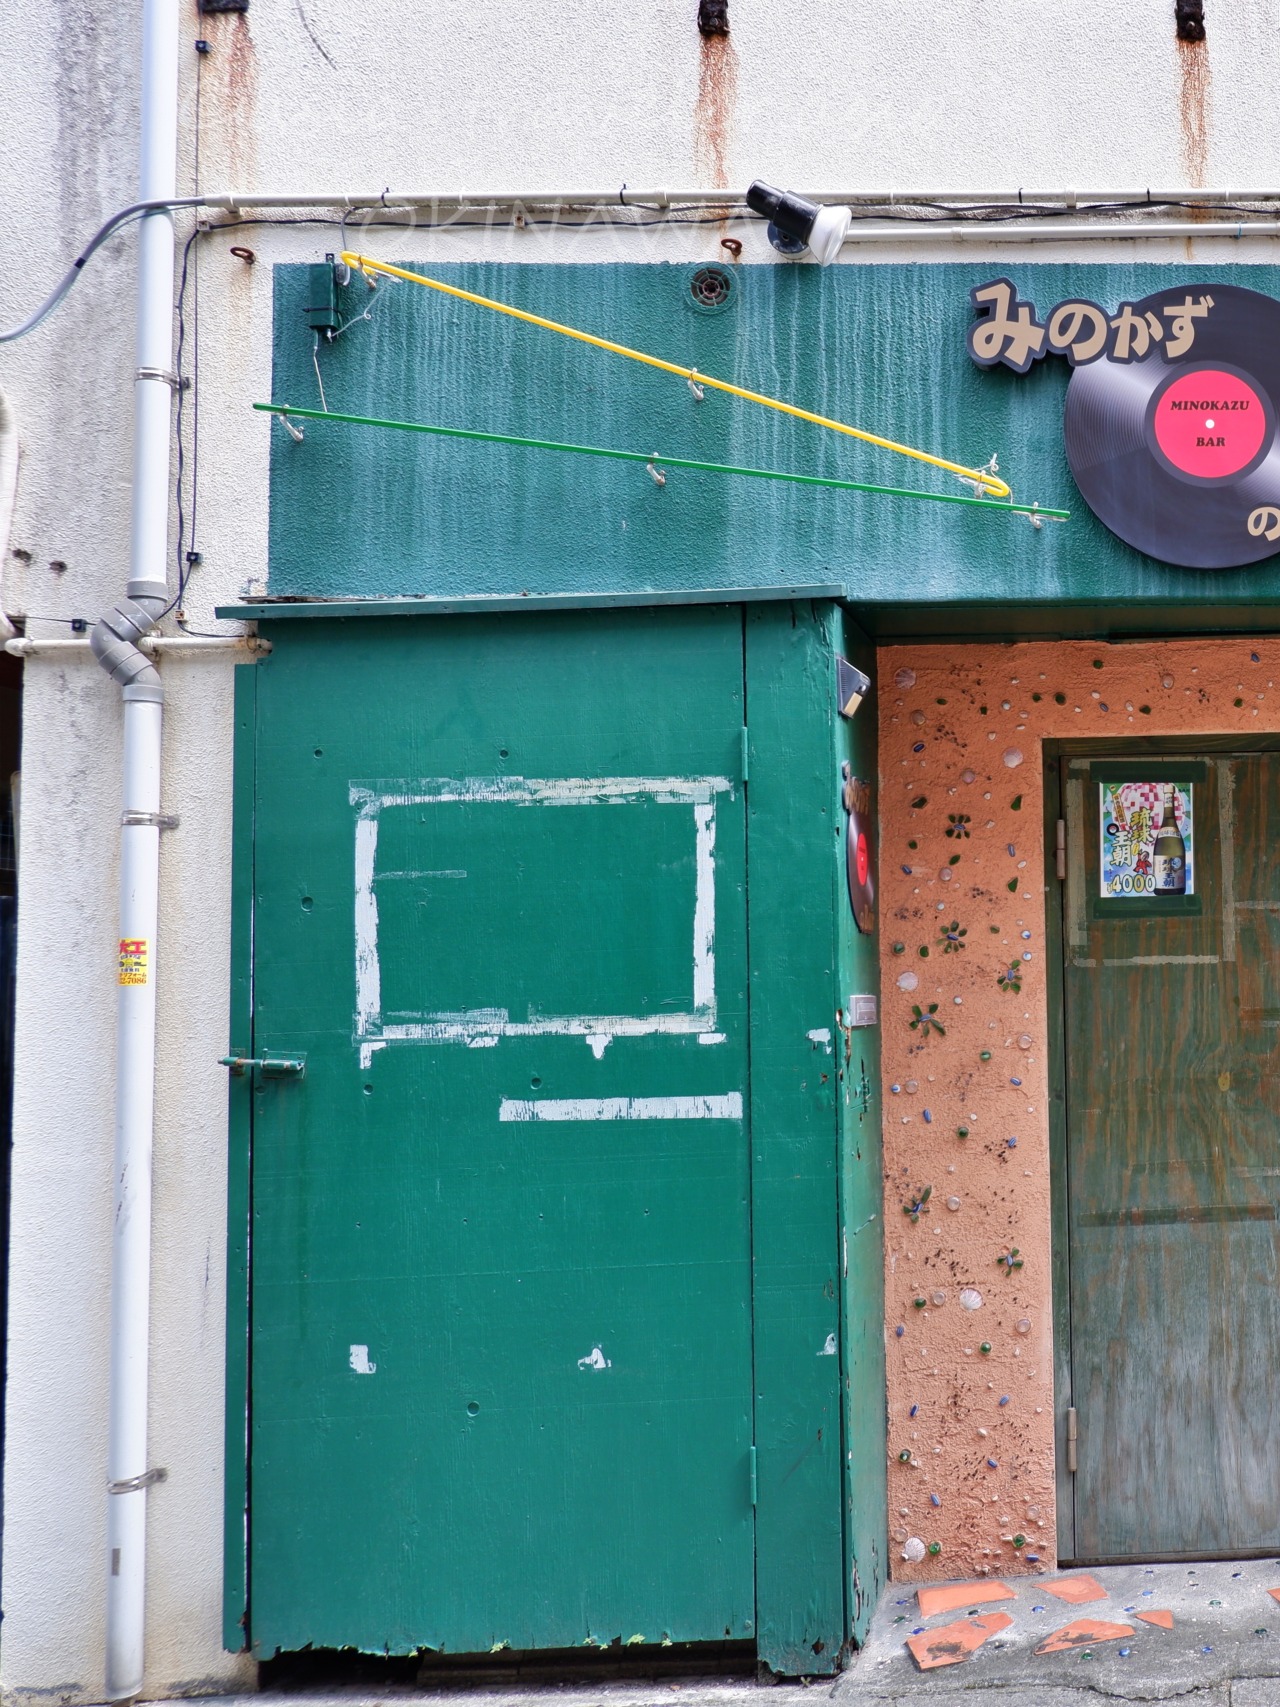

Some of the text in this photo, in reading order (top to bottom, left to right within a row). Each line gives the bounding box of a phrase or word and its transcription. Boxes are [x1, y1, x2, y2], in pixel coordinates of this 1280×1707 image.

[972, 282, 1215, 366] みのかず
[1170, 400, 1250, 411] MINOKAZU
[1195, 437, 1226, 447] BAR
